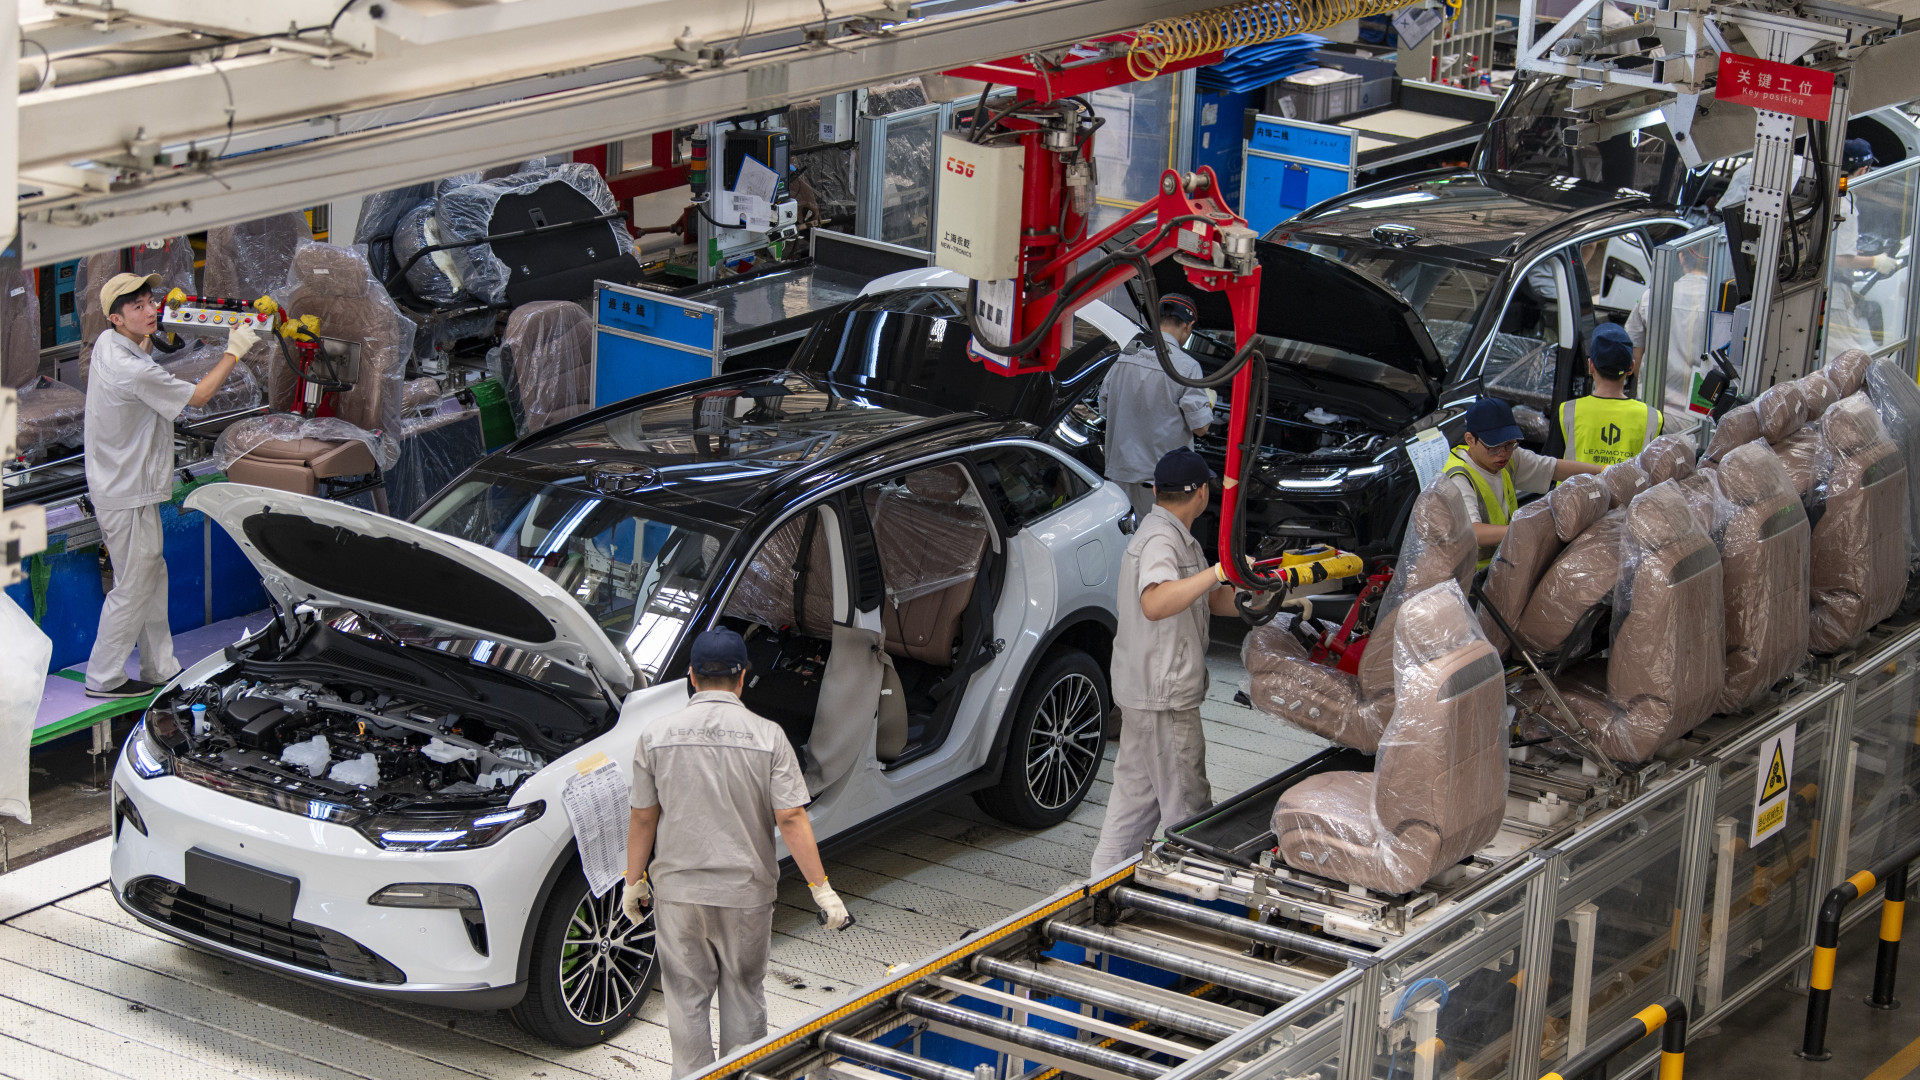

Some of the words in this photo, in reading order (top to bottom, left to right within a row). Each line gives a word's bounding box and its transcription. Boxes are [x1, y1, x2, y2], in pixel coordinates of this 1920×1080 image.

[1737, 68, 1812, 97] 关键工位
[1742, 87, 1760, 98] Key
[1762, 92, 1804, 106] position
[946, 156, 975, 178] CSG
[669, 728, 754, 741] LEAPMOTOR
